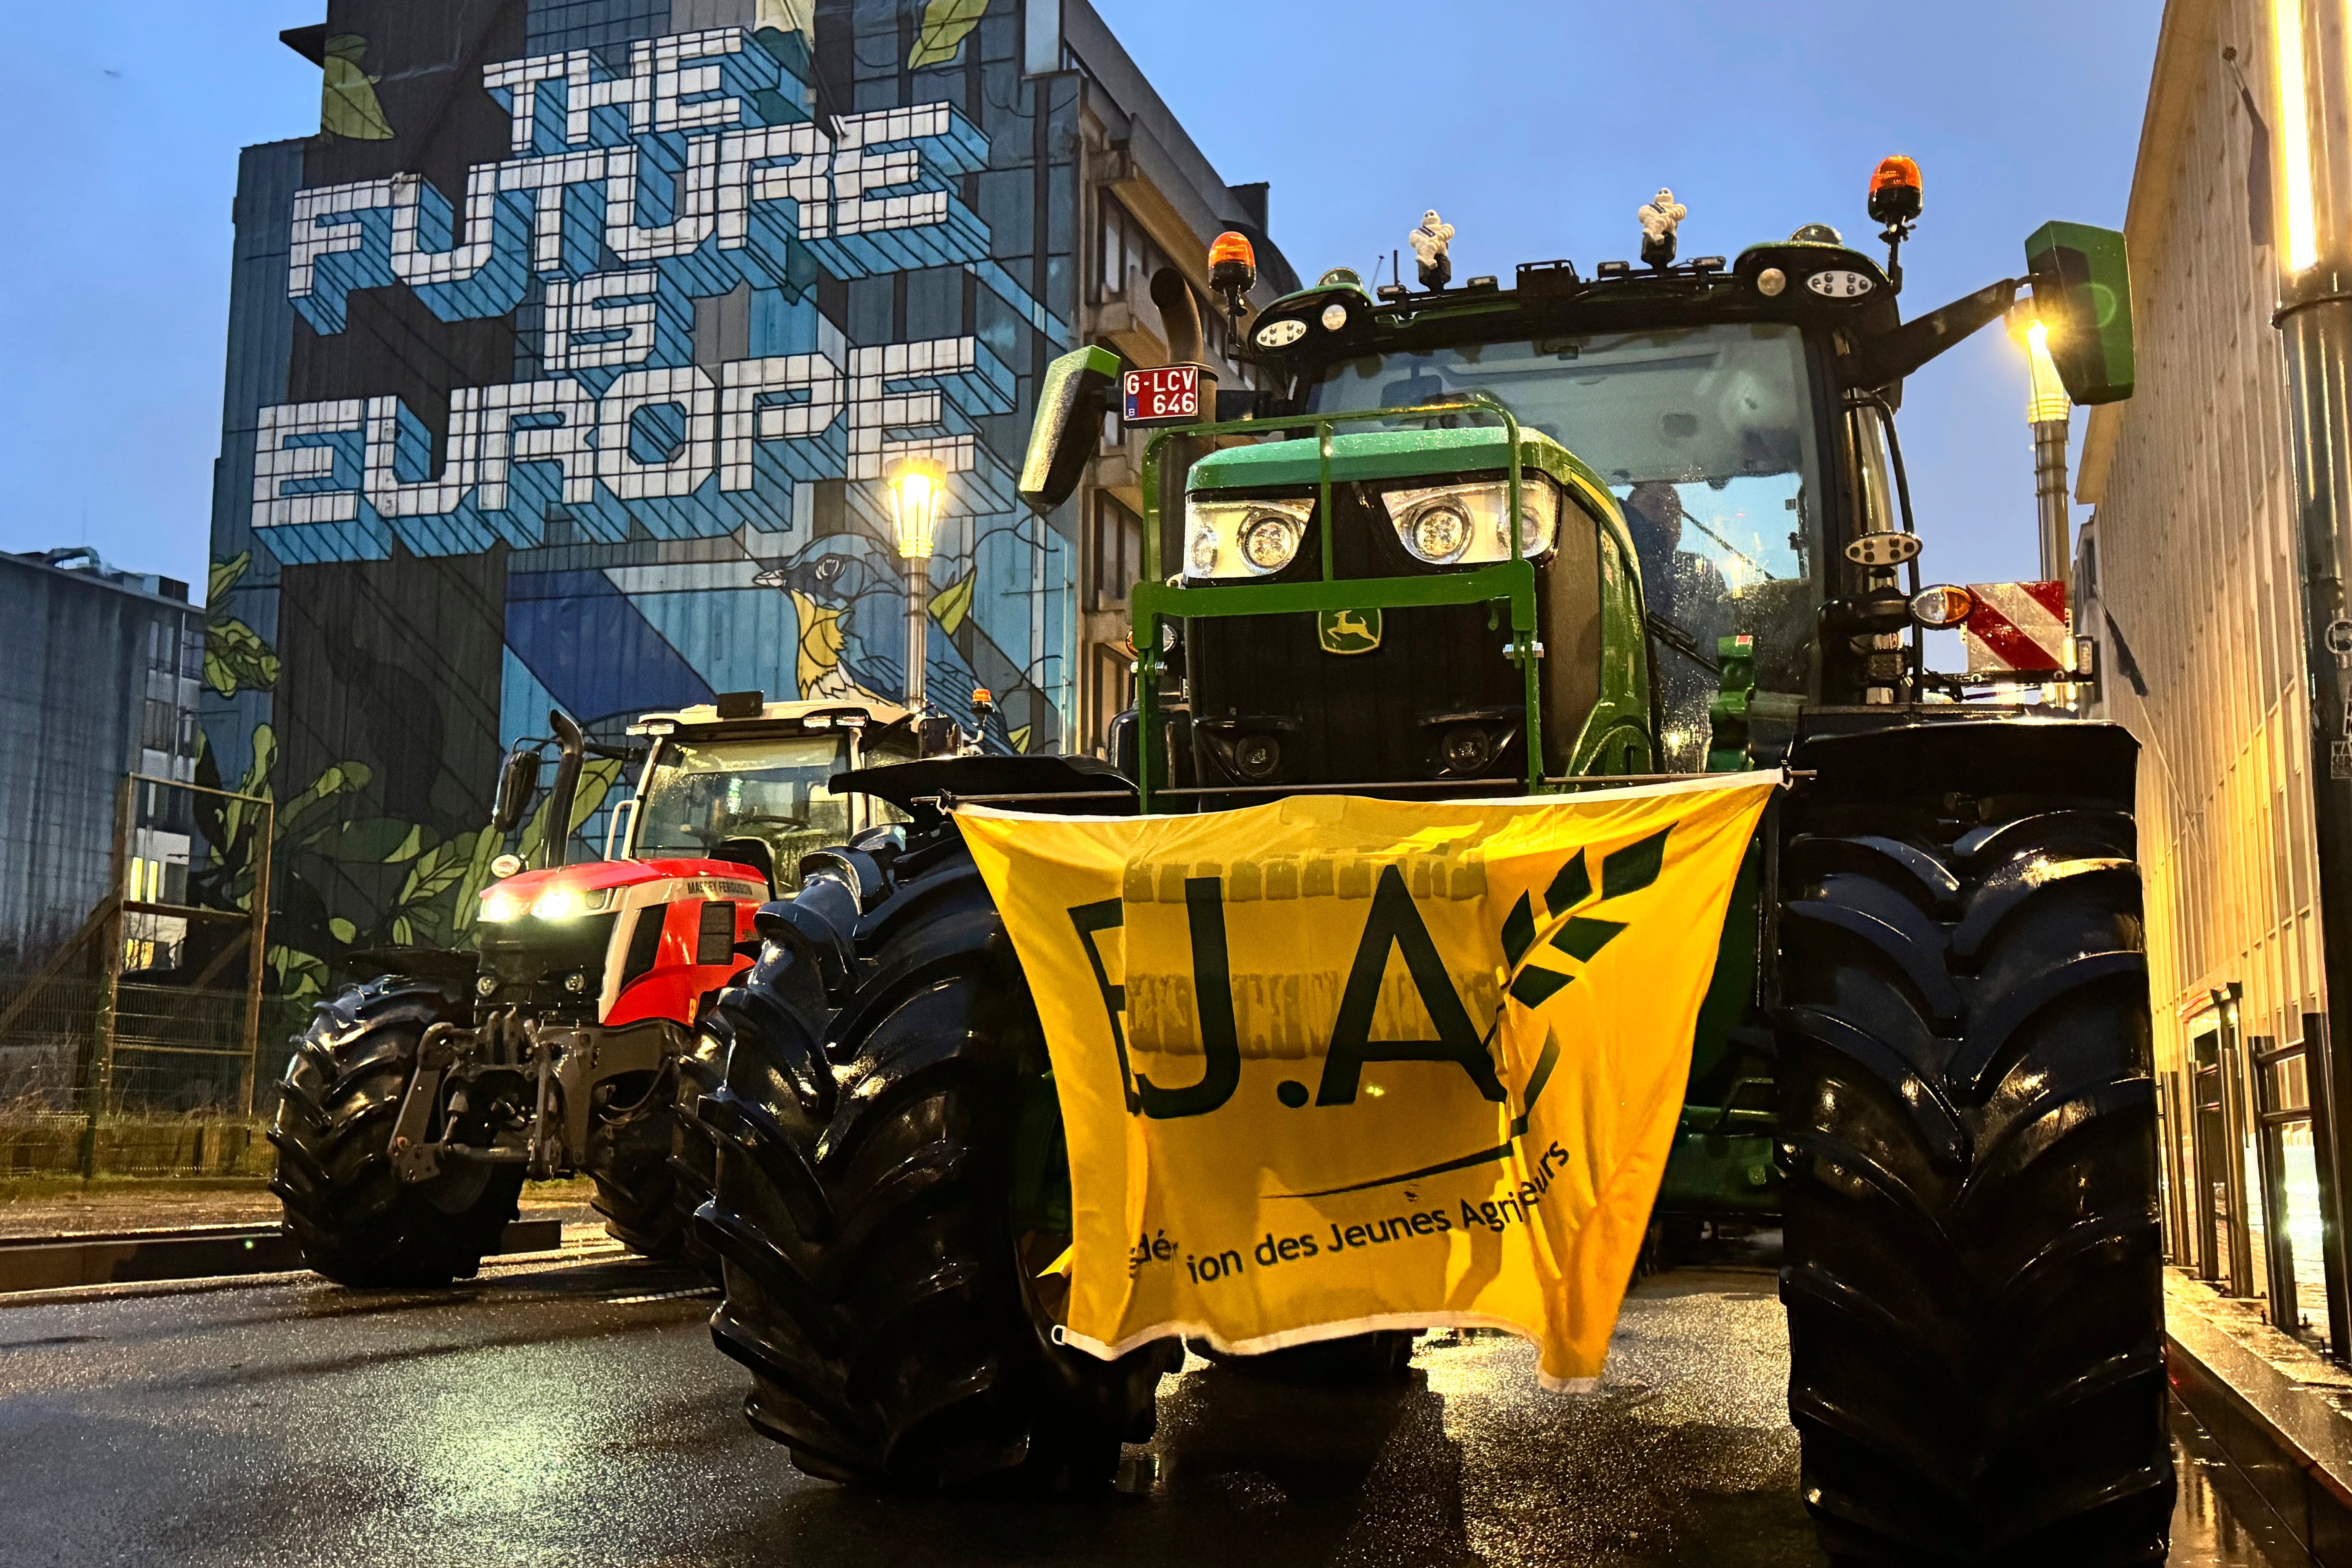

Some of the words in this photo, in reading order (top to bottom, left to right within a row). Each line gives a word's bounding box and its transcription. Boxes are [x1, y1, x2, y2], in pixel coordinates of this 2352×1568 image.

[483, 26, 744, 152] THE
[288, 101, 951, 299] FUTURE
[544, 267, 658, 370] IS
[251, 336, 975, 528] EUROPE
[1127, 370, 1194, 395] G-LCV
[1153, 392, 1194, 414] 646
[1255, 1233, 1319, 1266] des
[1328, 1210, 1452, 1253] Jeunes
